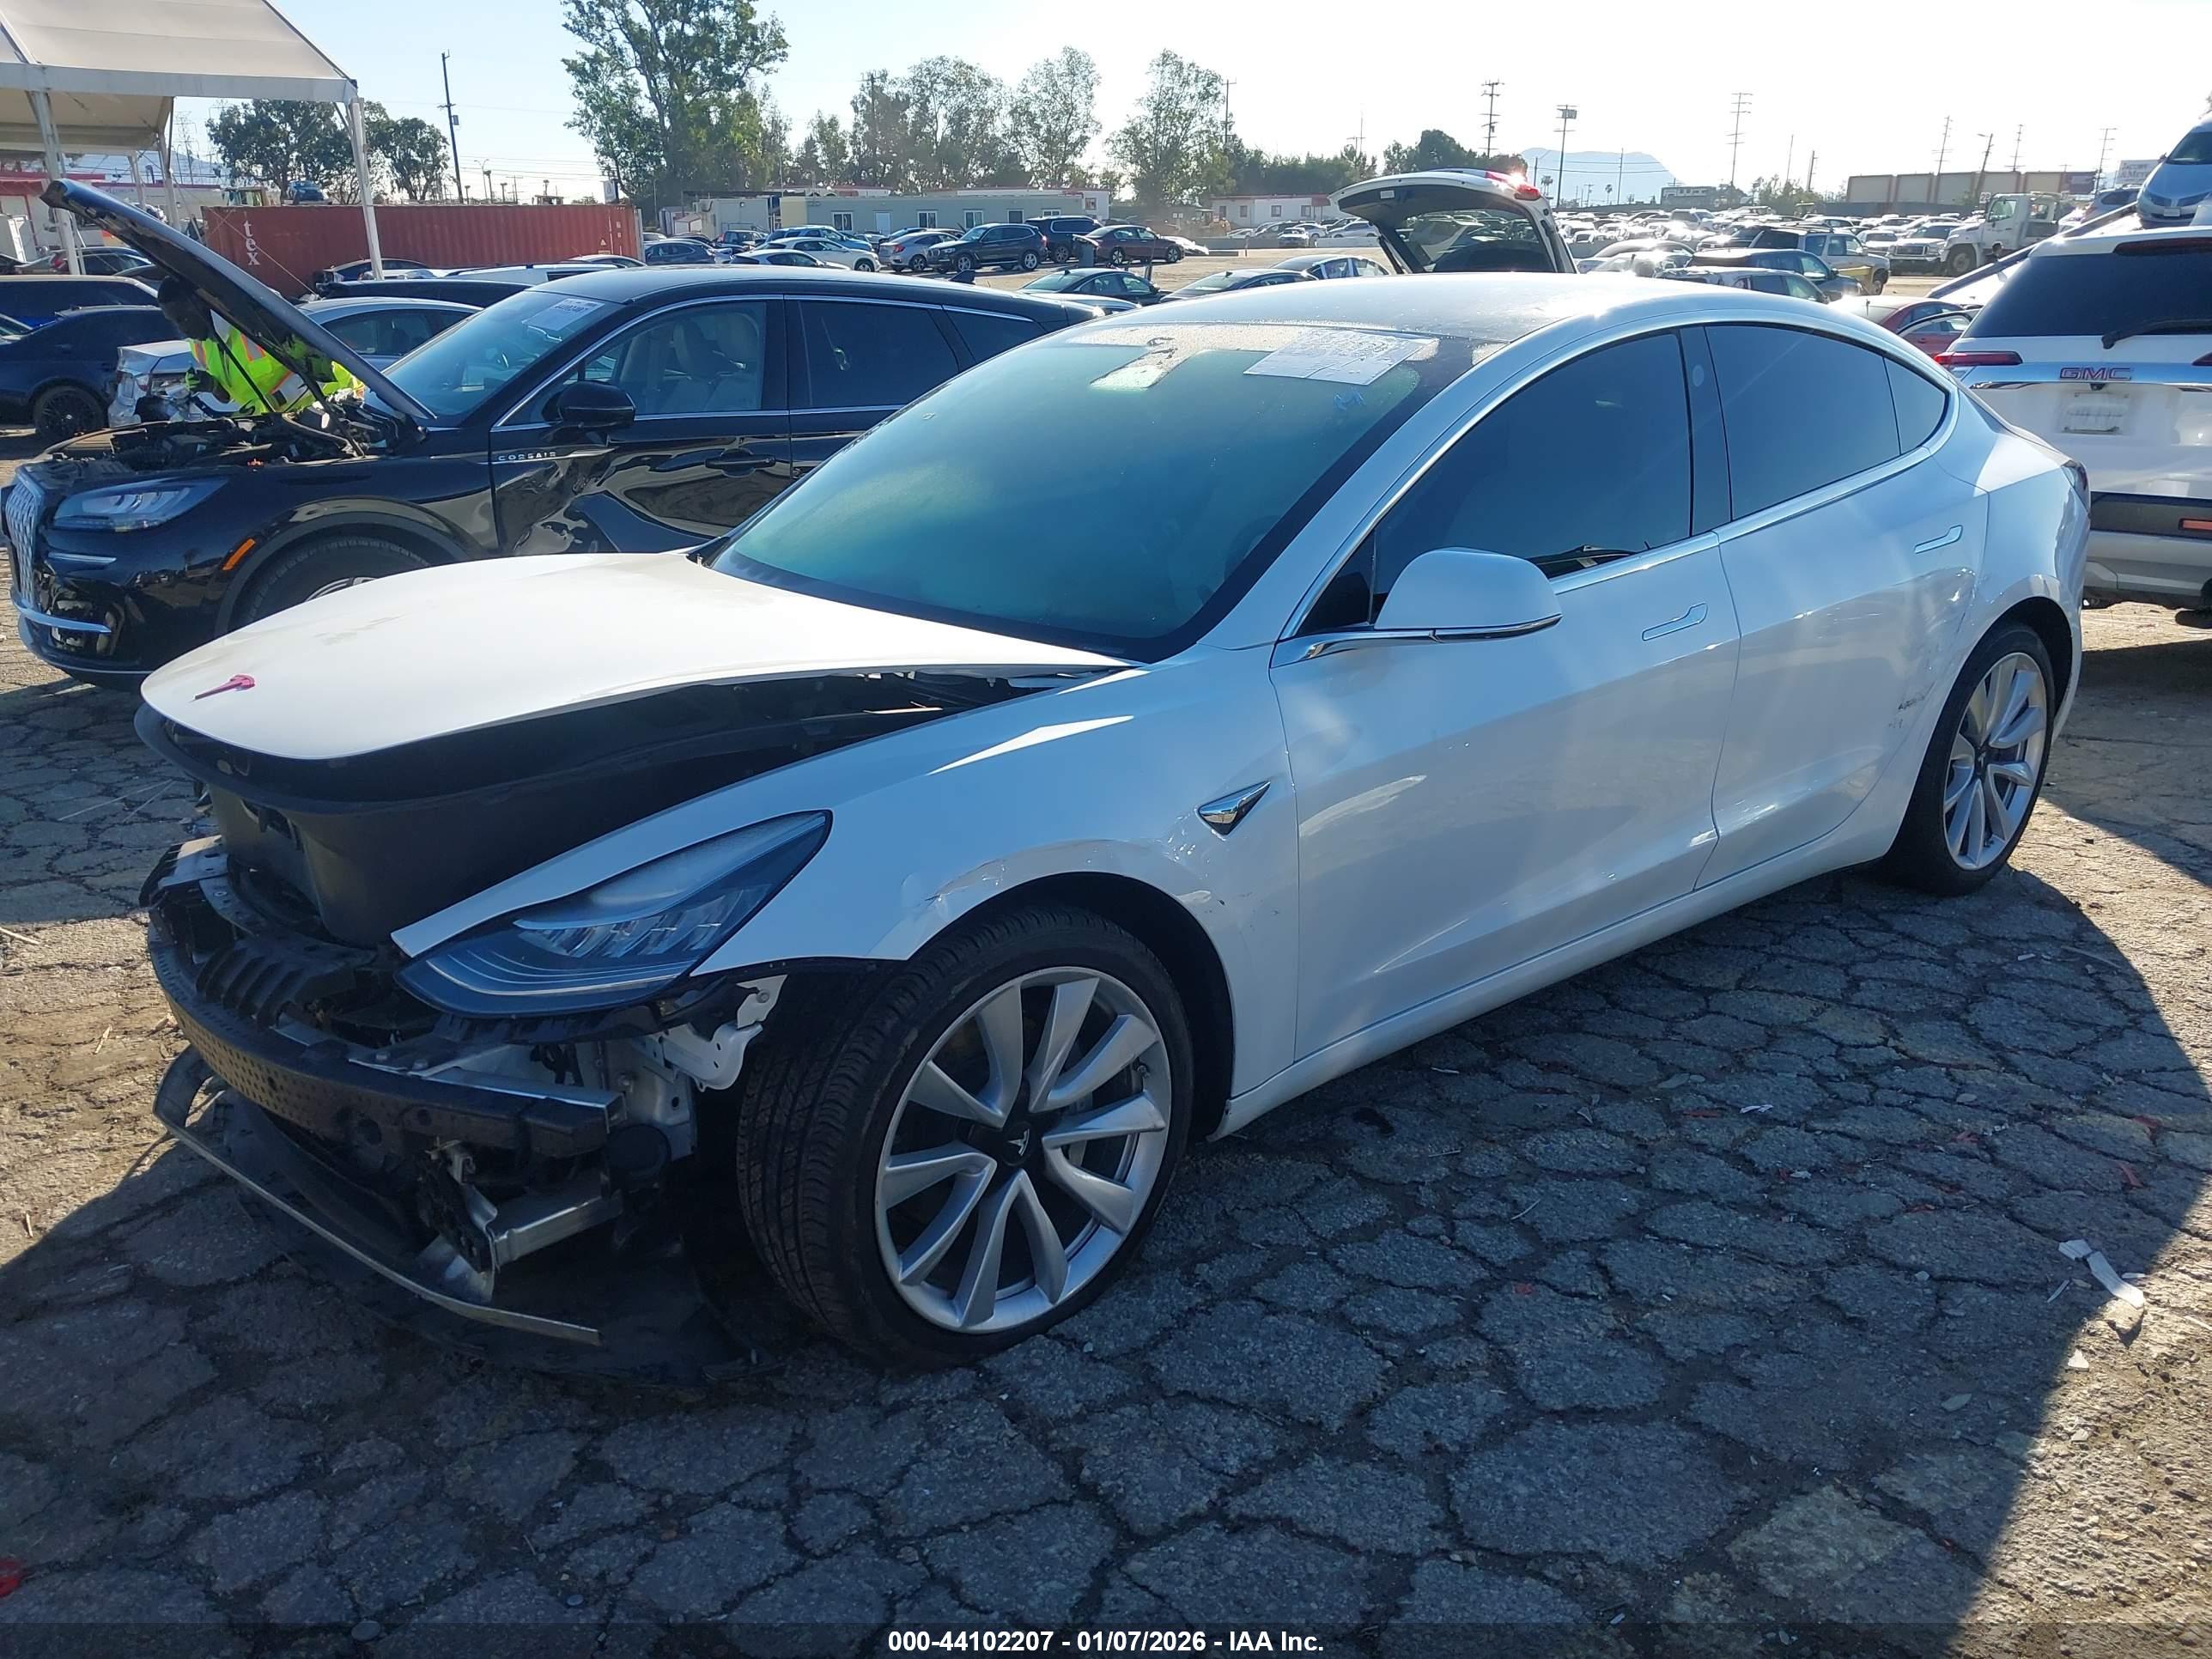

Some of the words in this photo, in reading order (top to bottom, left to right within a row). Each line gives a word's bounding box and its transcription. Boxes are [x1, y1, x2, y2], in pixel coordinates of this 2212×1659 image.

[244, 220, 261, 265] tex
[2060, 367, 2131, 380] GMC
[498, 452, 556, 461] CORSAIR
